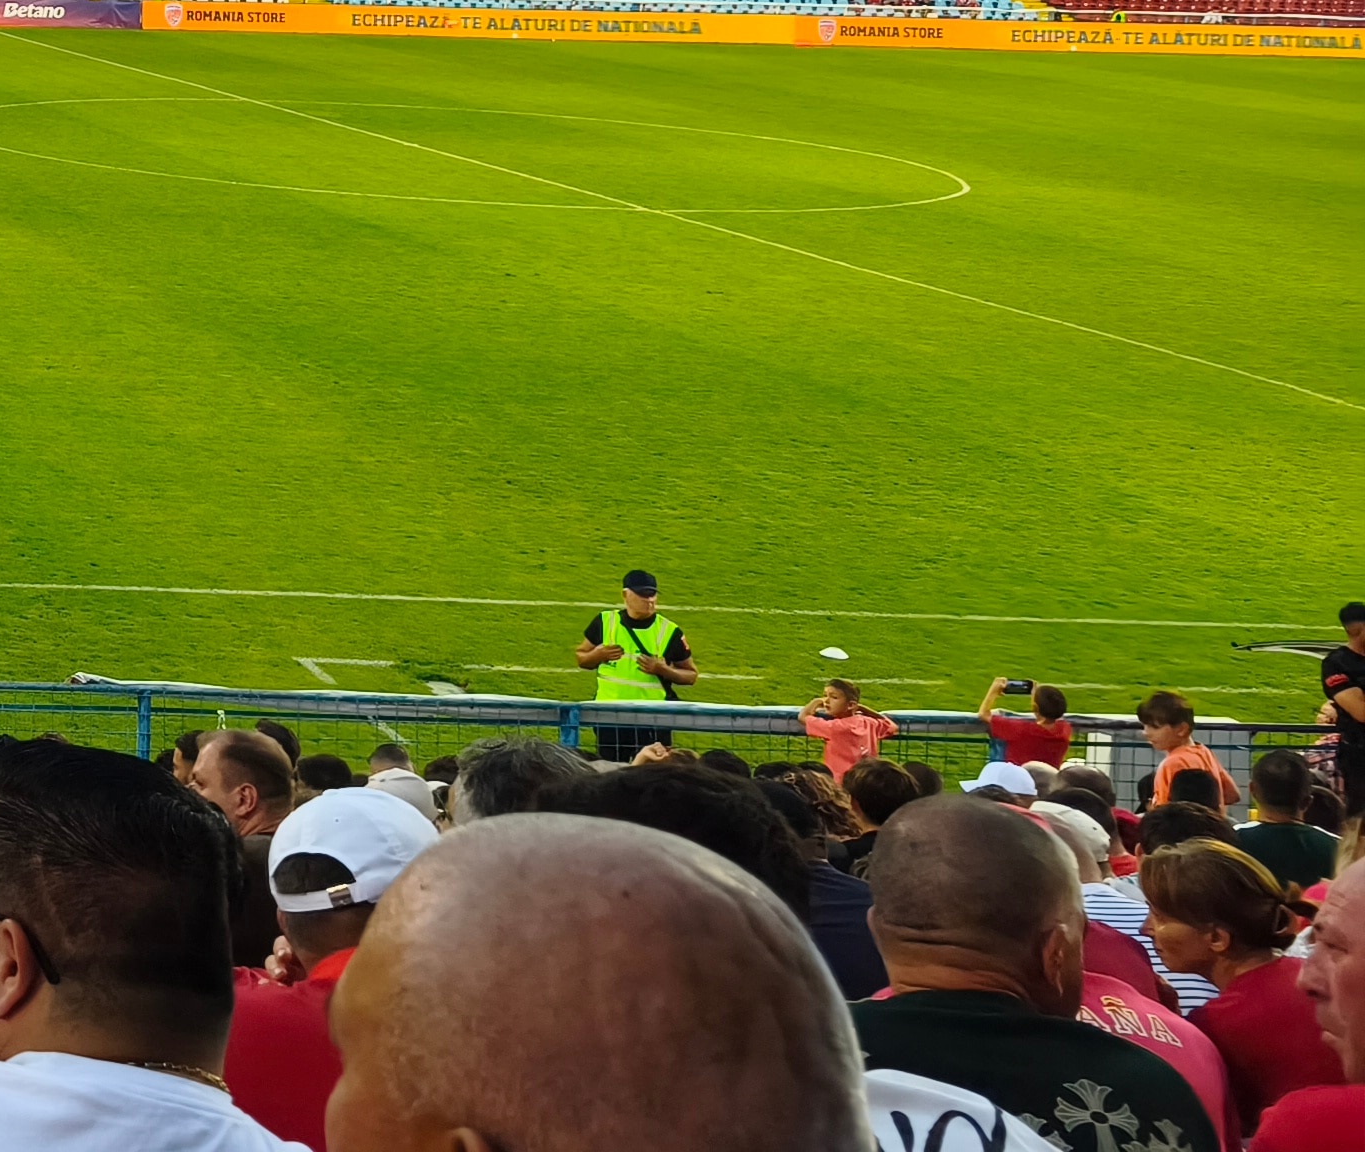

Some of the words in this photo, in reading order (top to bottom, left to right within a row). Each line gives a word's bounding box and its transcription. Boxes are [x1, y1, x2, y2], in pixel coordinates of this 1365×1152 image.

[3, 2, 66, 19] Betano
[186, 10, 244, 22] ROMANIA
[247, 11, 286, 23] STORE
[569, 19, 593, 32] DE
[840, 25, 900, 38] ROMANIA
[903, 26, 944, 39] STORE
[1232, 34, 1255, 47] DE
[1075, 995, 1184, 1048] AÑA
